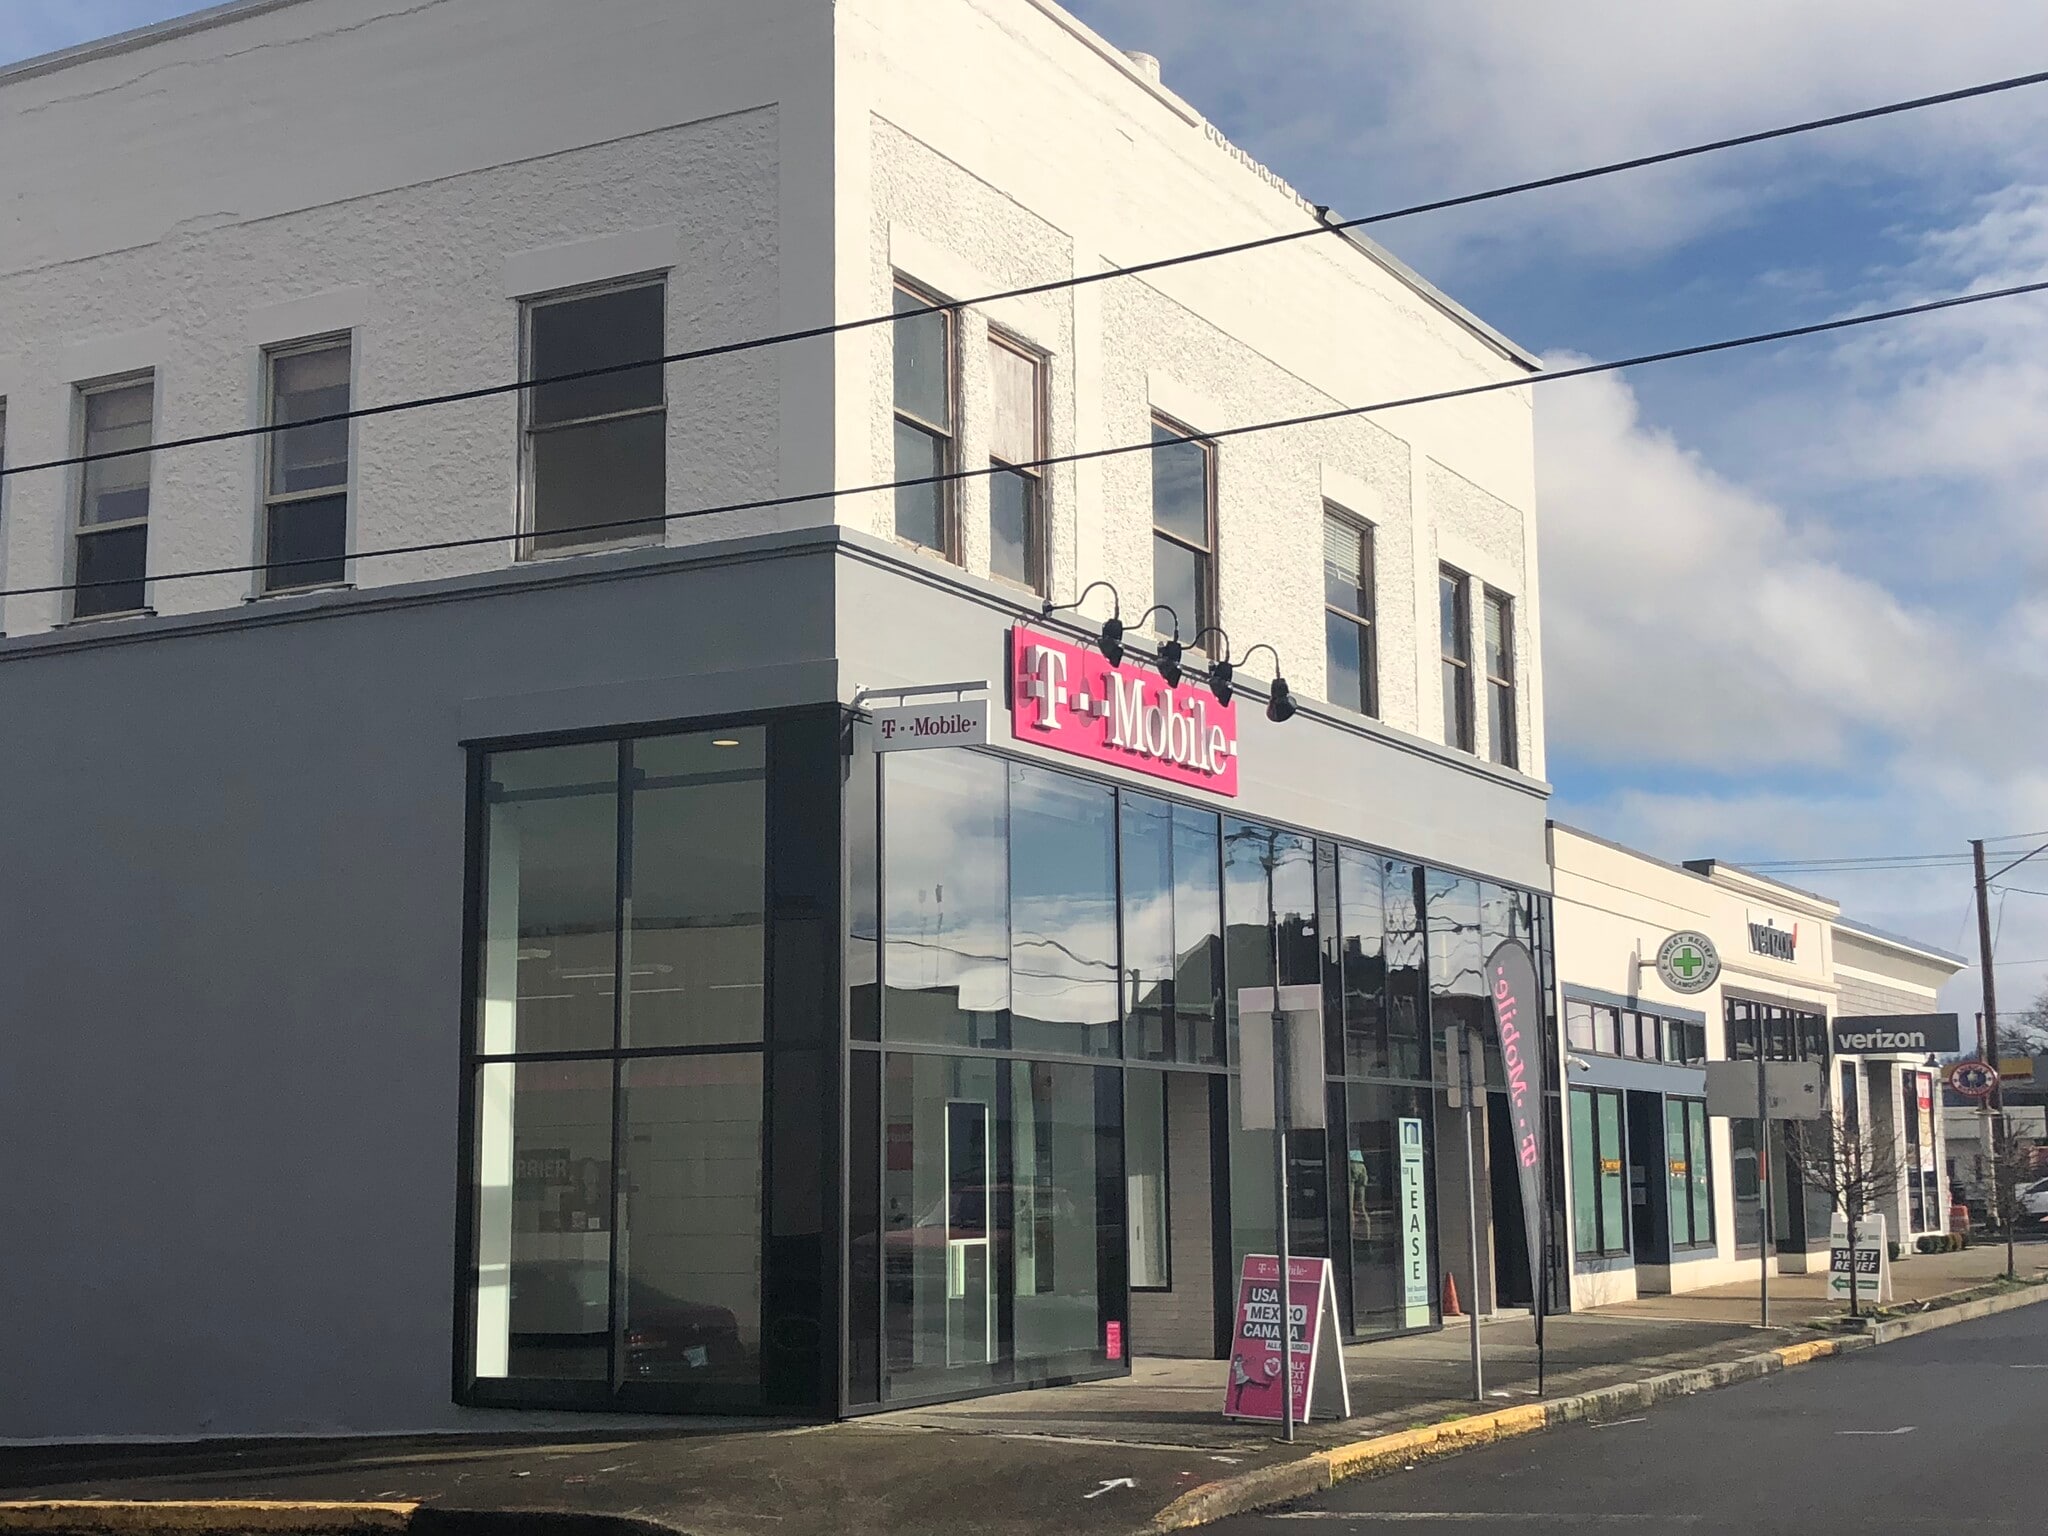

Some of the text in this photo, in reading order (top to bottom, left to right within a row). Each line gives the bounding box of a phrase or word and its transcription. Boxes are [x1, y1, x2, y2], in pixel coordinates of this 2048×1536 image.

[1662, 936, 1713, 960] SWEET RELIEF
[1748, 918, 1795, 961] verizon
[1839, 1028, 1925, 1050] verizon
[1410, 1167, 1421, 1280] LEASE
[1834, 1261, 1877, 1272] REIEF
[1251, 1287, 1279, 1303] USA
[1250, 1306, 1303, 1322] MEXO
[1243, 1323, 1299, 1340] CANAA
